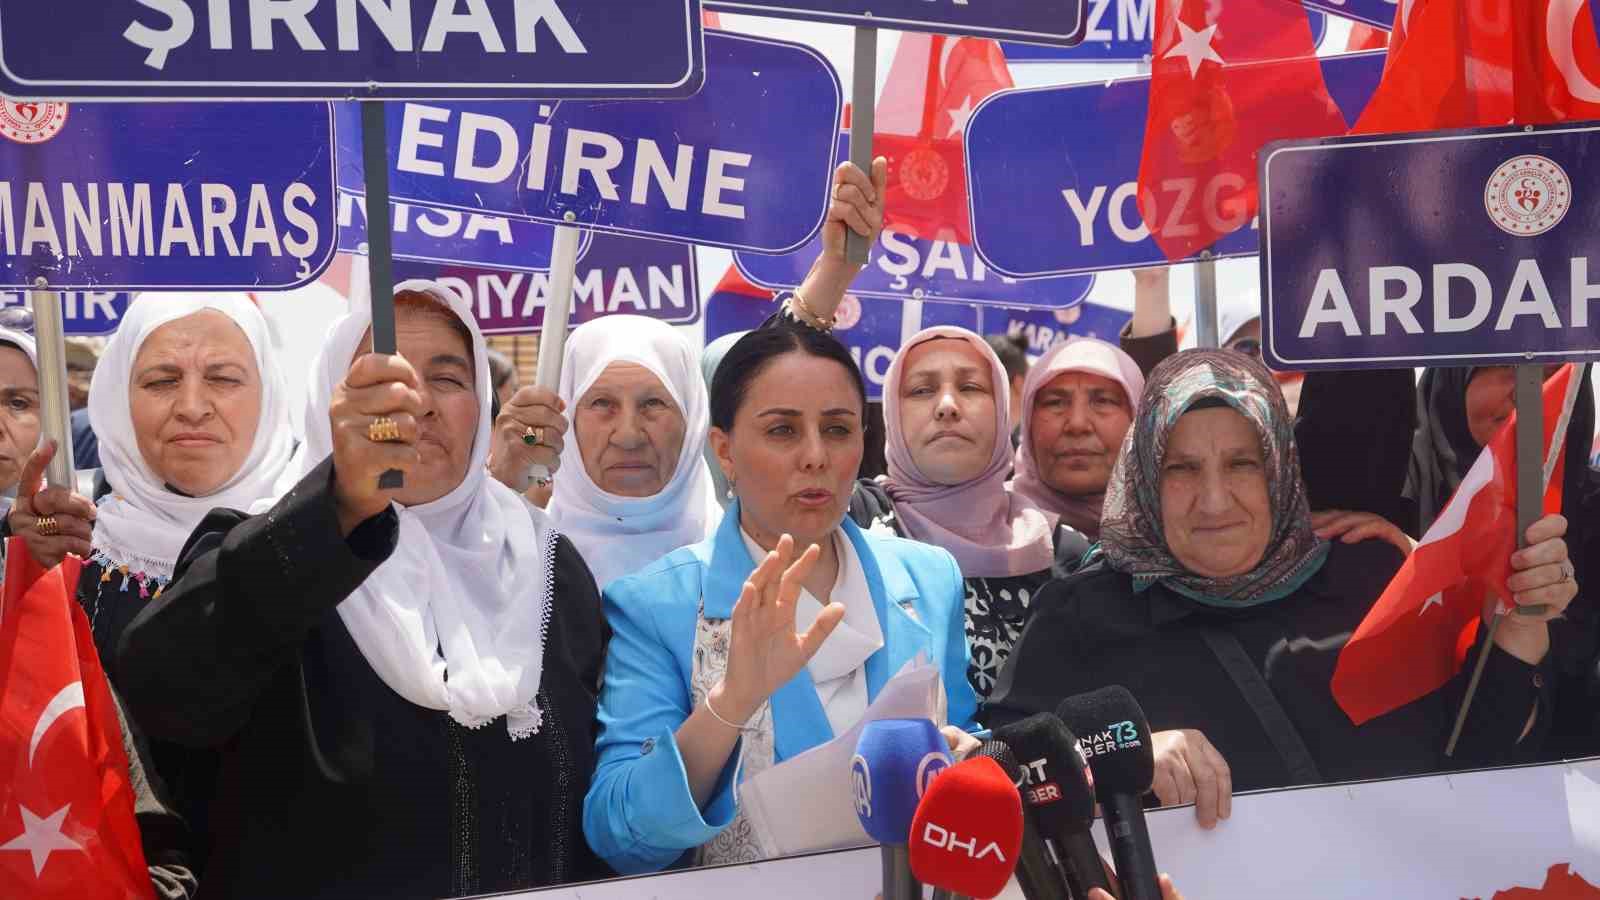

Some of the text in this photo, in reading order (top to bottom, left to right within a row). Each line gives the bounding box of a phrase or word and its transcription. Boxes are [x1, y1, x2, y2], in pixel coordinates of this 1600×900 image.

[397, 102, 753, 220] EDİRNE
[1061, 172, 1259, 247] YOZG
[923, 821, 1006, 863] DHA
